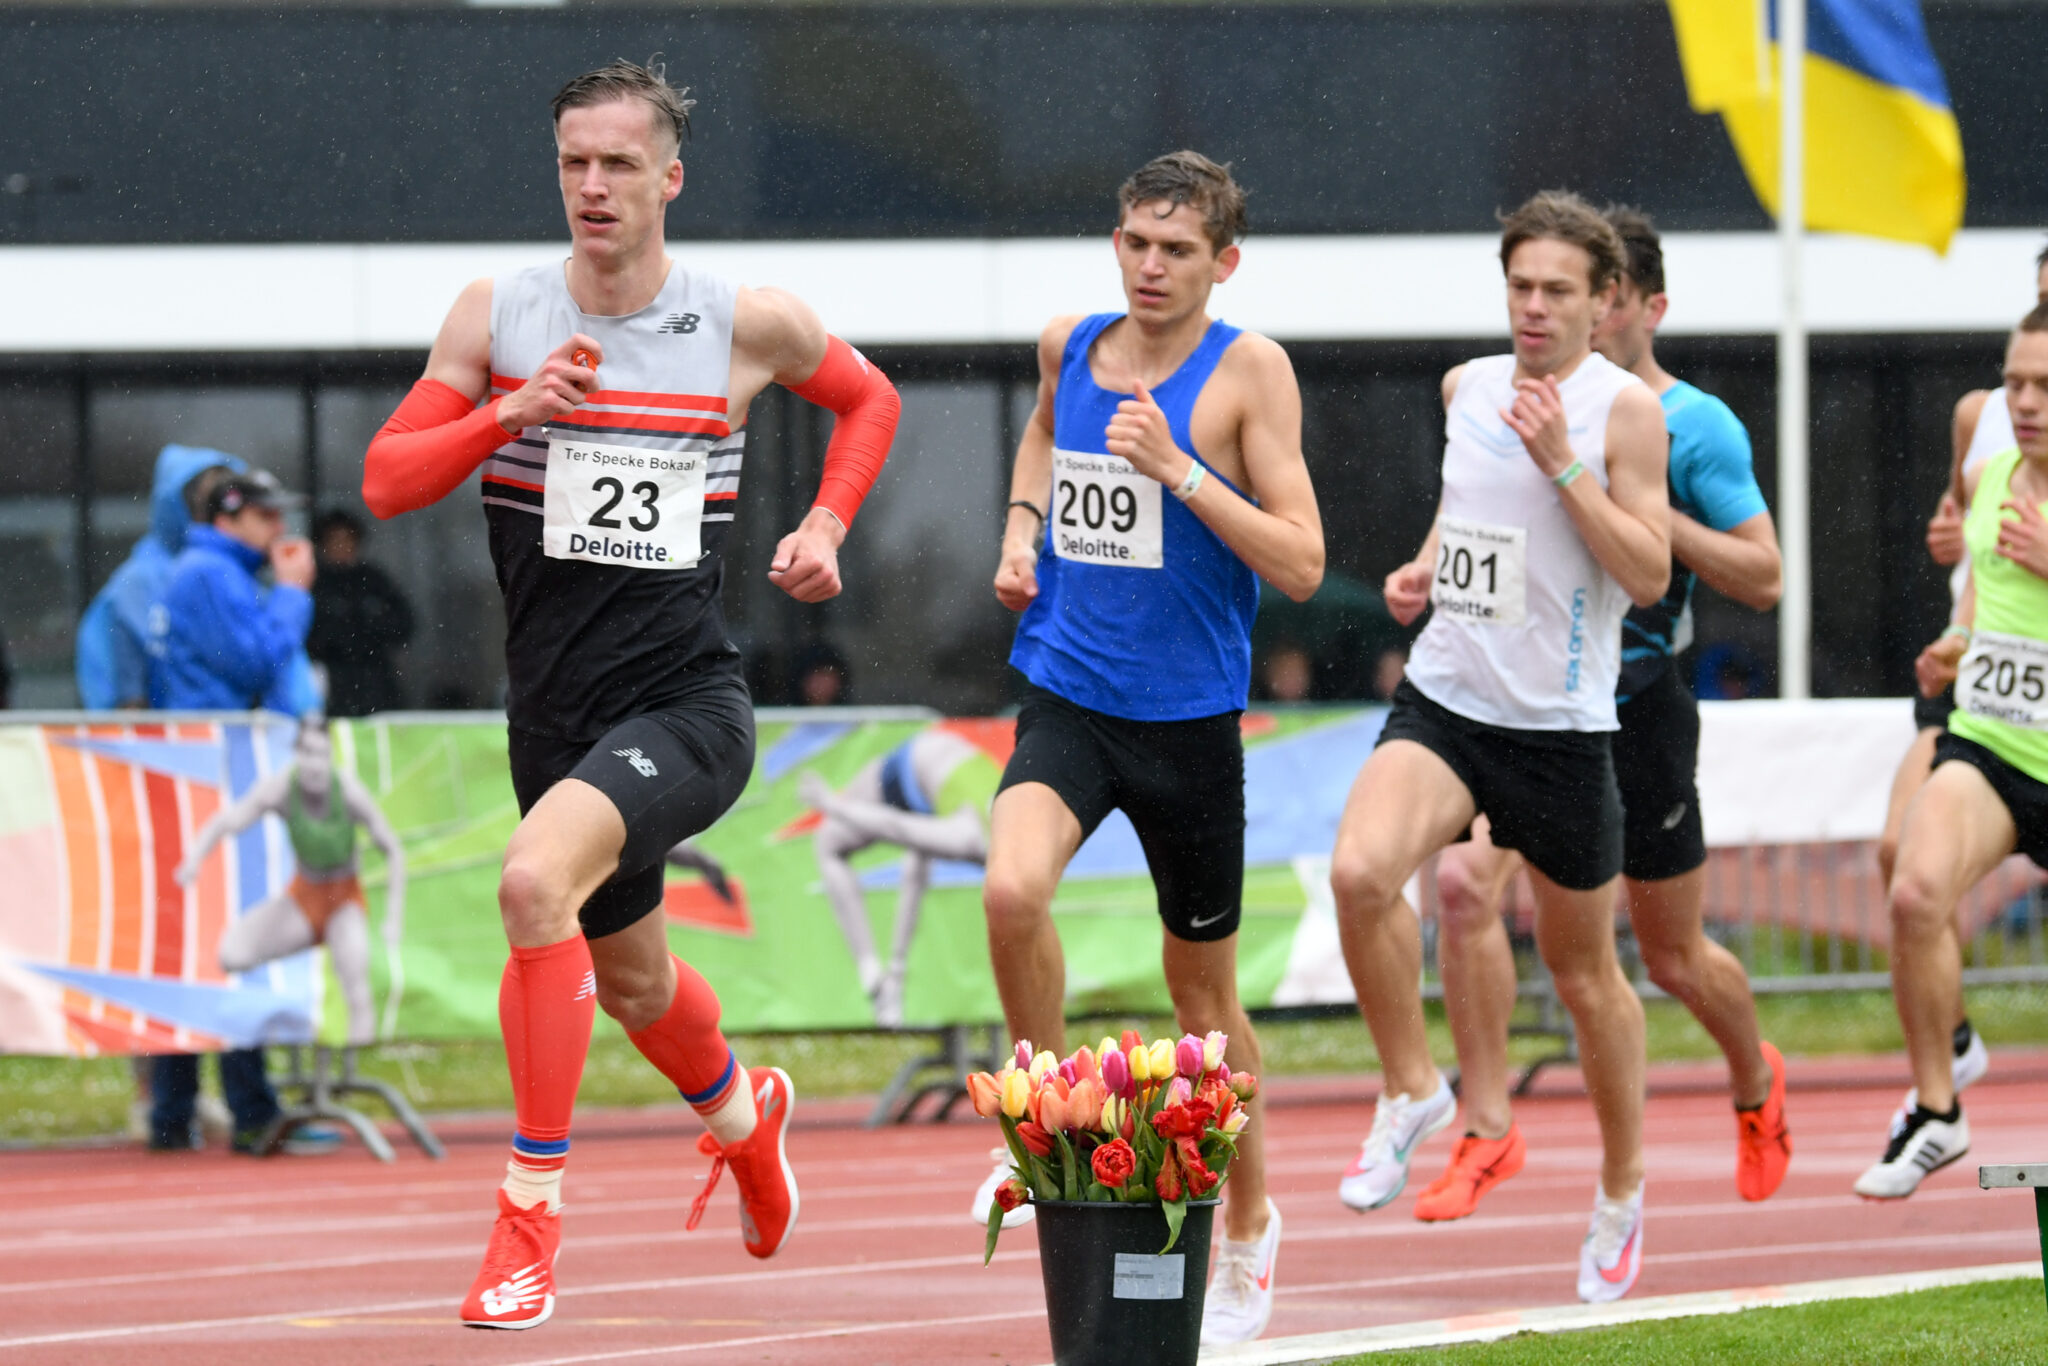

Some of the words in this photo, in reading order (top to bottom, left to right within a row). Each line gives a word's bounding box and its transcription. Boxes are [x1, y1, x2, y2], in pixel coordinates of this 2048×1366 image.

[564, 448, 588, 462] Ter
[592, 451, 645, 468] Specke
[650, 456, 696, 471] Bokaal
[1065, 457, 1104, 473] Specke
[588, 476, 660, 532] 23
[1058, 479, 1137, 533] 209
[1438, 544, 1497, 594] 201
[1973, 654, 2044, 701] 205
